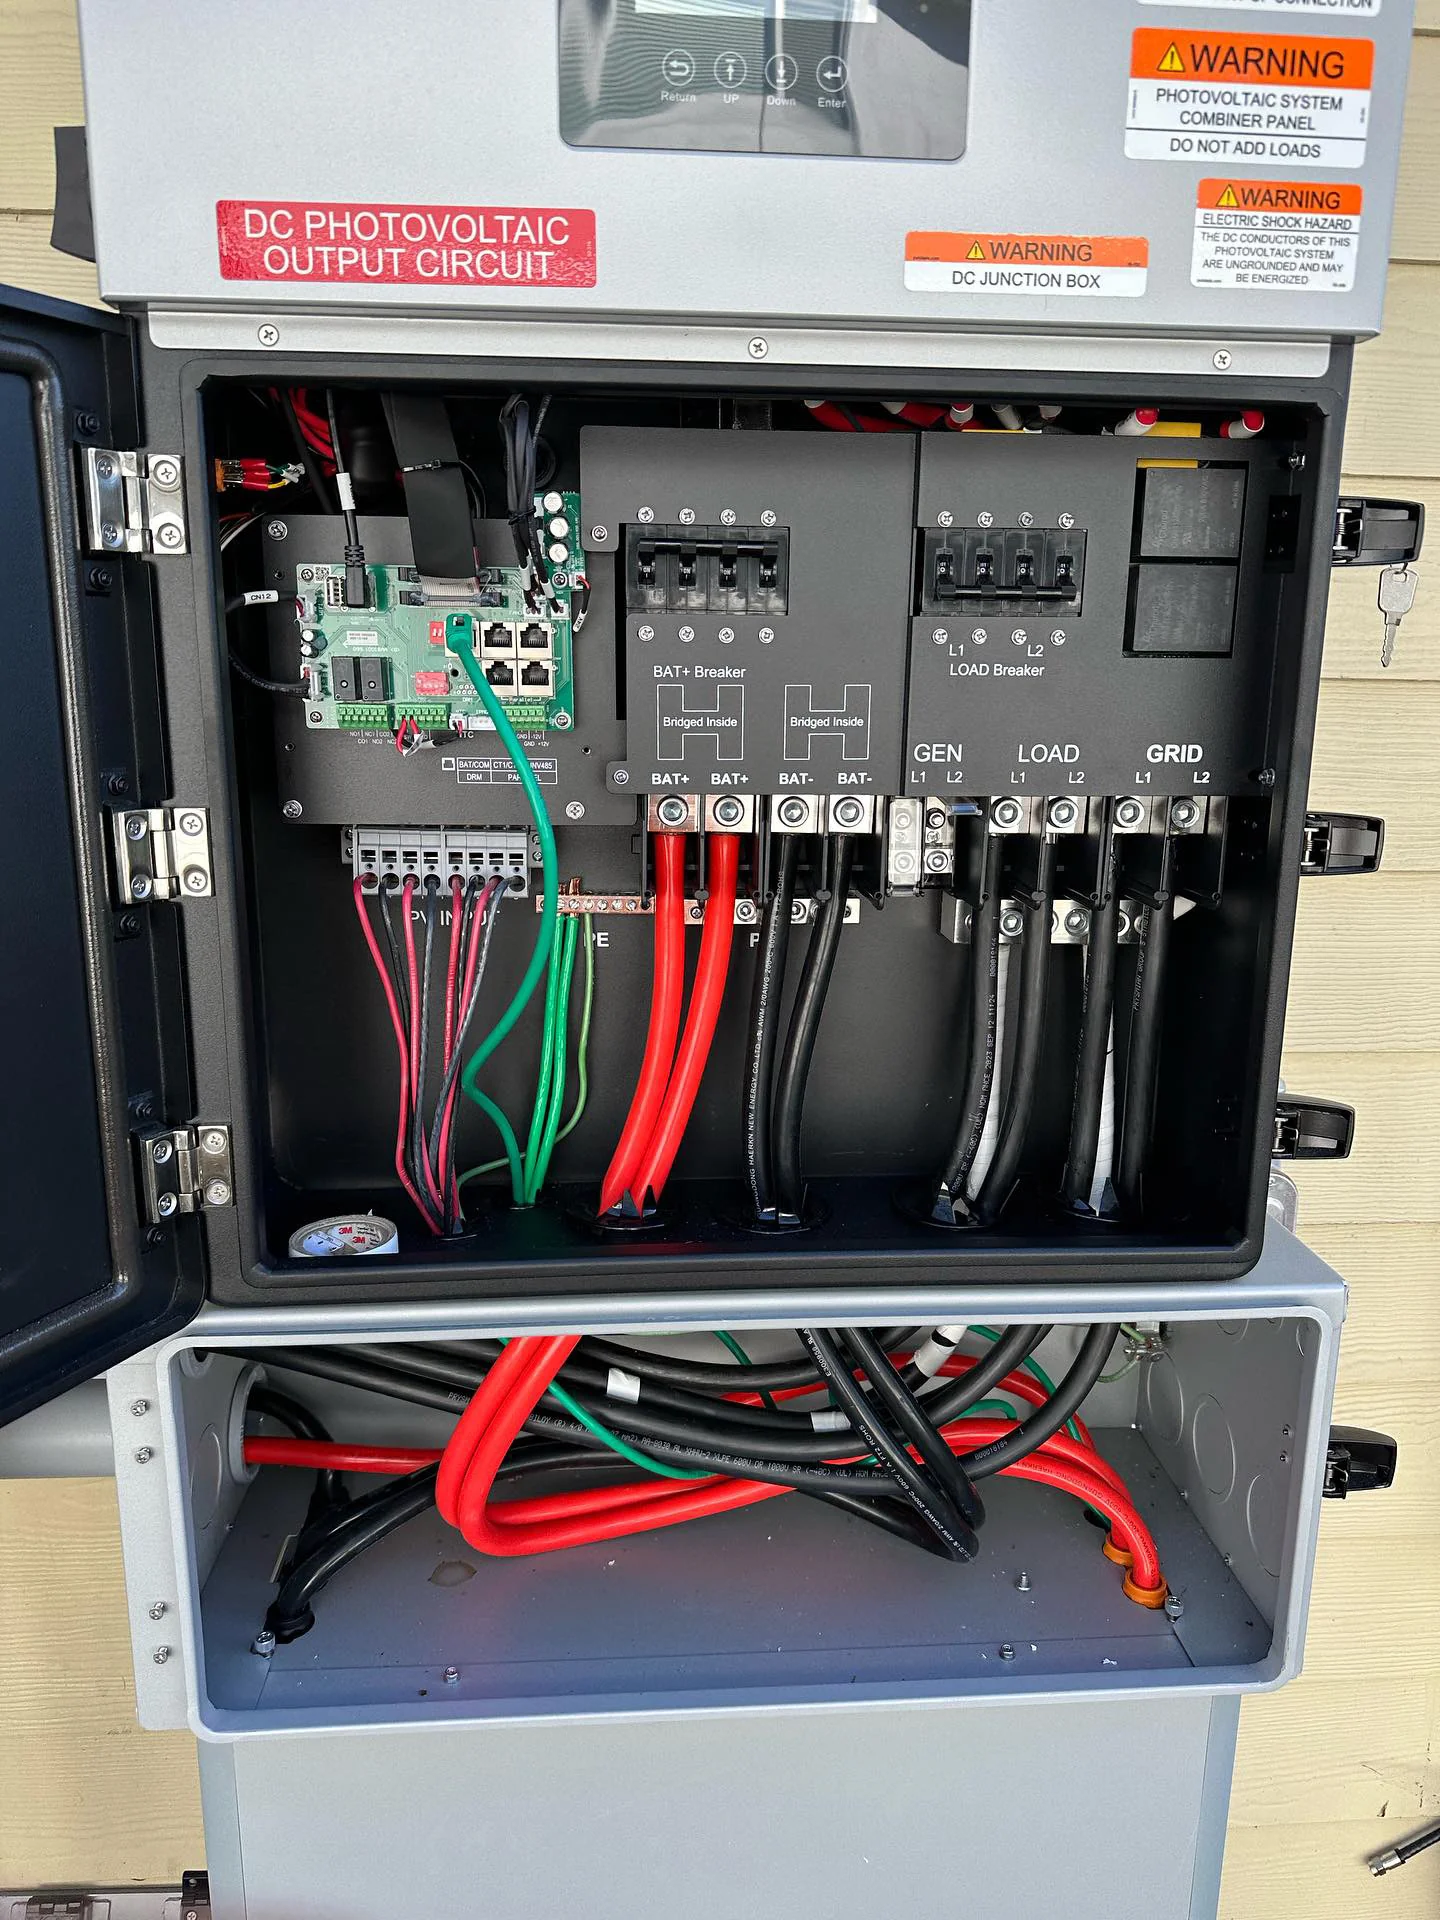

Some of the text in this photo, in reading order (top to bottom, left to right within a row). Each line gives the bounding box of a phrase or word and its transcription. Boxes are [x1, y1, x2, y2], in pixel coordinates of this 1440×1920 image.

[1190, 44, 1345, 79] WARNING
[661, 91, 696, 102] Return
[723, 93, 739, 104] UP
[766, 95, 796, 106] Down
[817, 97, 847, 109] Enter
[1156, 88, 1276, 108] PHOTOVOLTAIC
[1281, 94, 1343, 111] SYSTEM
[1179, 110, 1316, 130] COMBINER PANEL
[1170, 138, 1321, 158] DO NOT ADD LOADS
[1240, 187, 1341, 210] WARNING
[244, 208, 570, 246] DC PHOTOVOLTAIC
[1202, 213, 1352, 230] ELECTRIC SHOCK HAZARD
[1201, 231, 1351, 247] THE DC CONDUCTORS OF THIS
[989, 241, 1093, 262] WARNING
[1214, 246, 1334, 259] PHOTOVOLTAIC SYSTEM
[263, 244, 405, 277] OUTPUT
[416, 248, 555, 280] CIRCUIT
[1202, 259, 1344, 273] ARE UNGROUNDED AND MAY
[952, 270, 1101, 288] DC JUNCTION BOX
[1235, 273, 1249, 283] BE
[1251, 274, 1309, 285] ENERGIZED
[250, 593, 272, 601] CN12
[948, 644, 964, 656] L1
[1027, 644, 1044, 657] L2
[653, 665, 746, 678] BAT+ Breaker
[950, 663, 1045, 677] LOAD Breaker
[663, 716, 738, 729] Bridged Inside
[790, 716, 864, 729] Bridged Inside
[914, 743, 963, 763] GEN
[1018, 744, 1080, 764] LOAD
[1146, 744, 1203, 764] GRID
[459, 761, 490, 769] BAT/COM
[466, 773, 482, 781] DRM
[651, 773, 690, 785] BAT+
[710, 773, 749, 785] BAT+
[779, 773, 814, 785] BAT-
[837, 773, 873, 785] BAT-
[911, 771, 963, 783] L1 L2
[1010, 771, 1085, 783] L1 L2
[1136, 771, 1210, 784] L1 L2
[338, 1226, 353, 1235] 3M
[352, 1236, 366, 1244] 3M
[859, 1424, 876, 1446] ROHS
